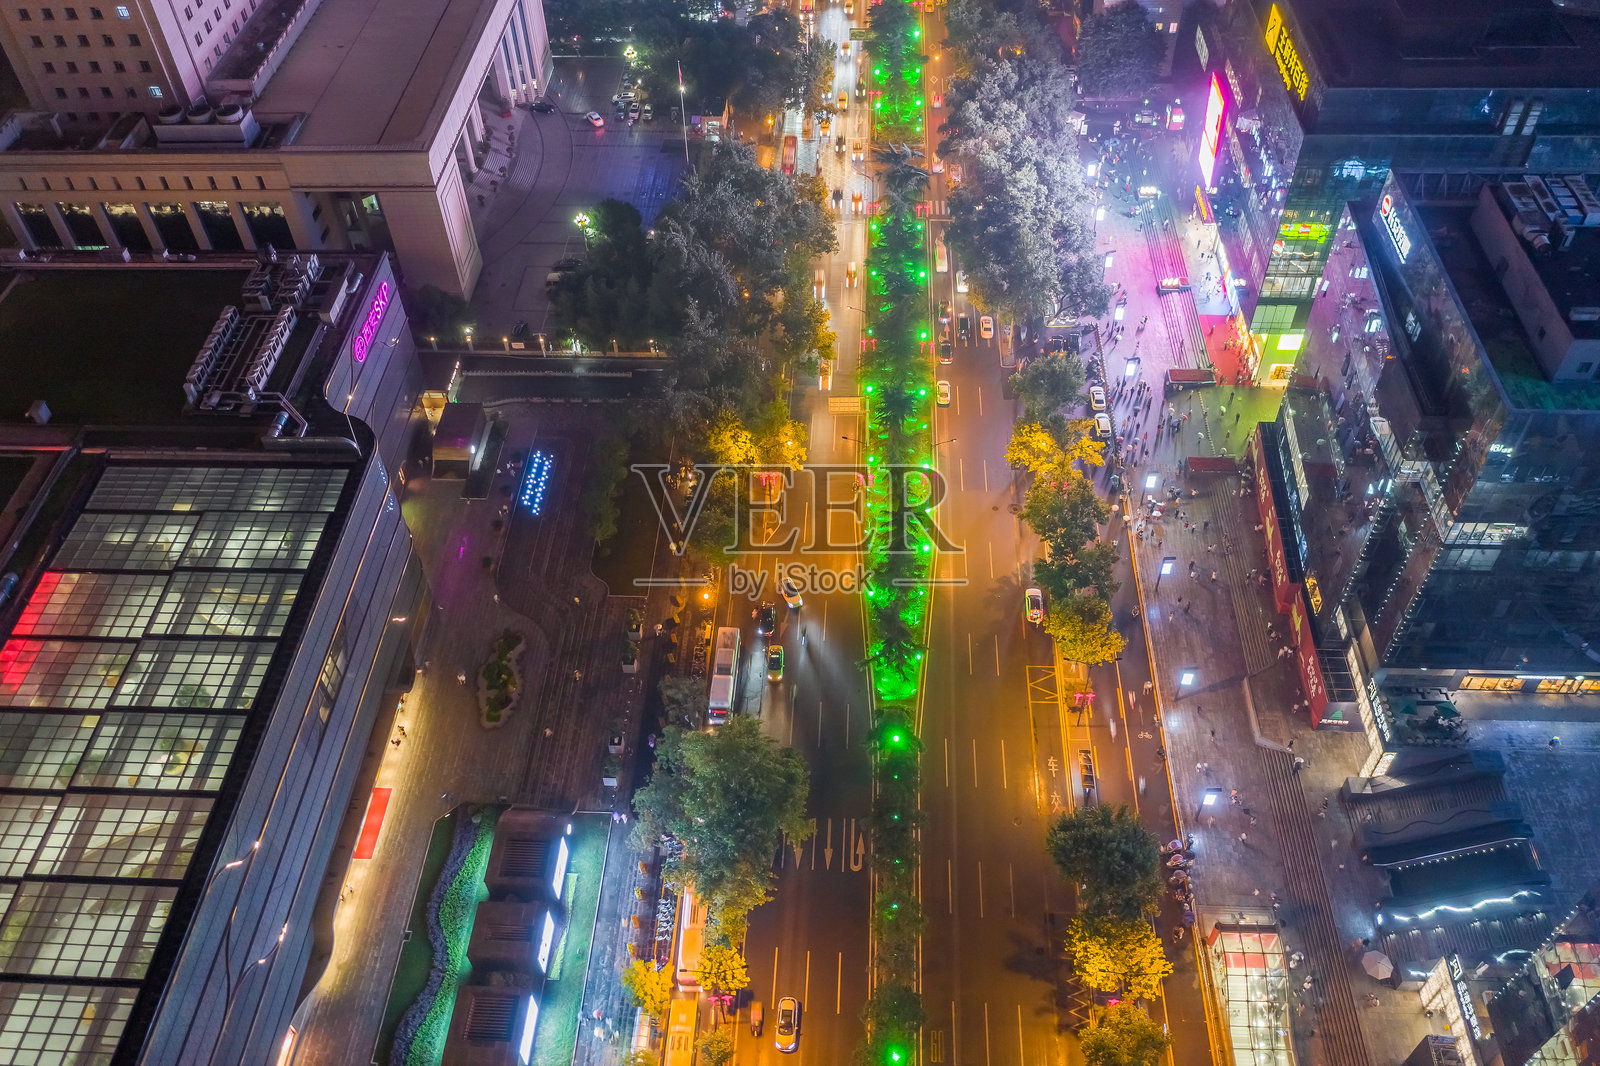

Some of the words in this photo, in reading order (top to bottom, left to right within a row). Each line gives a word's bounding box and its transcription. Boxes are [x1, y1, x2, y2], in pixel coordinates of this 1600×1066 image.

[1278, 26, 1309, 101] 王府井百货
